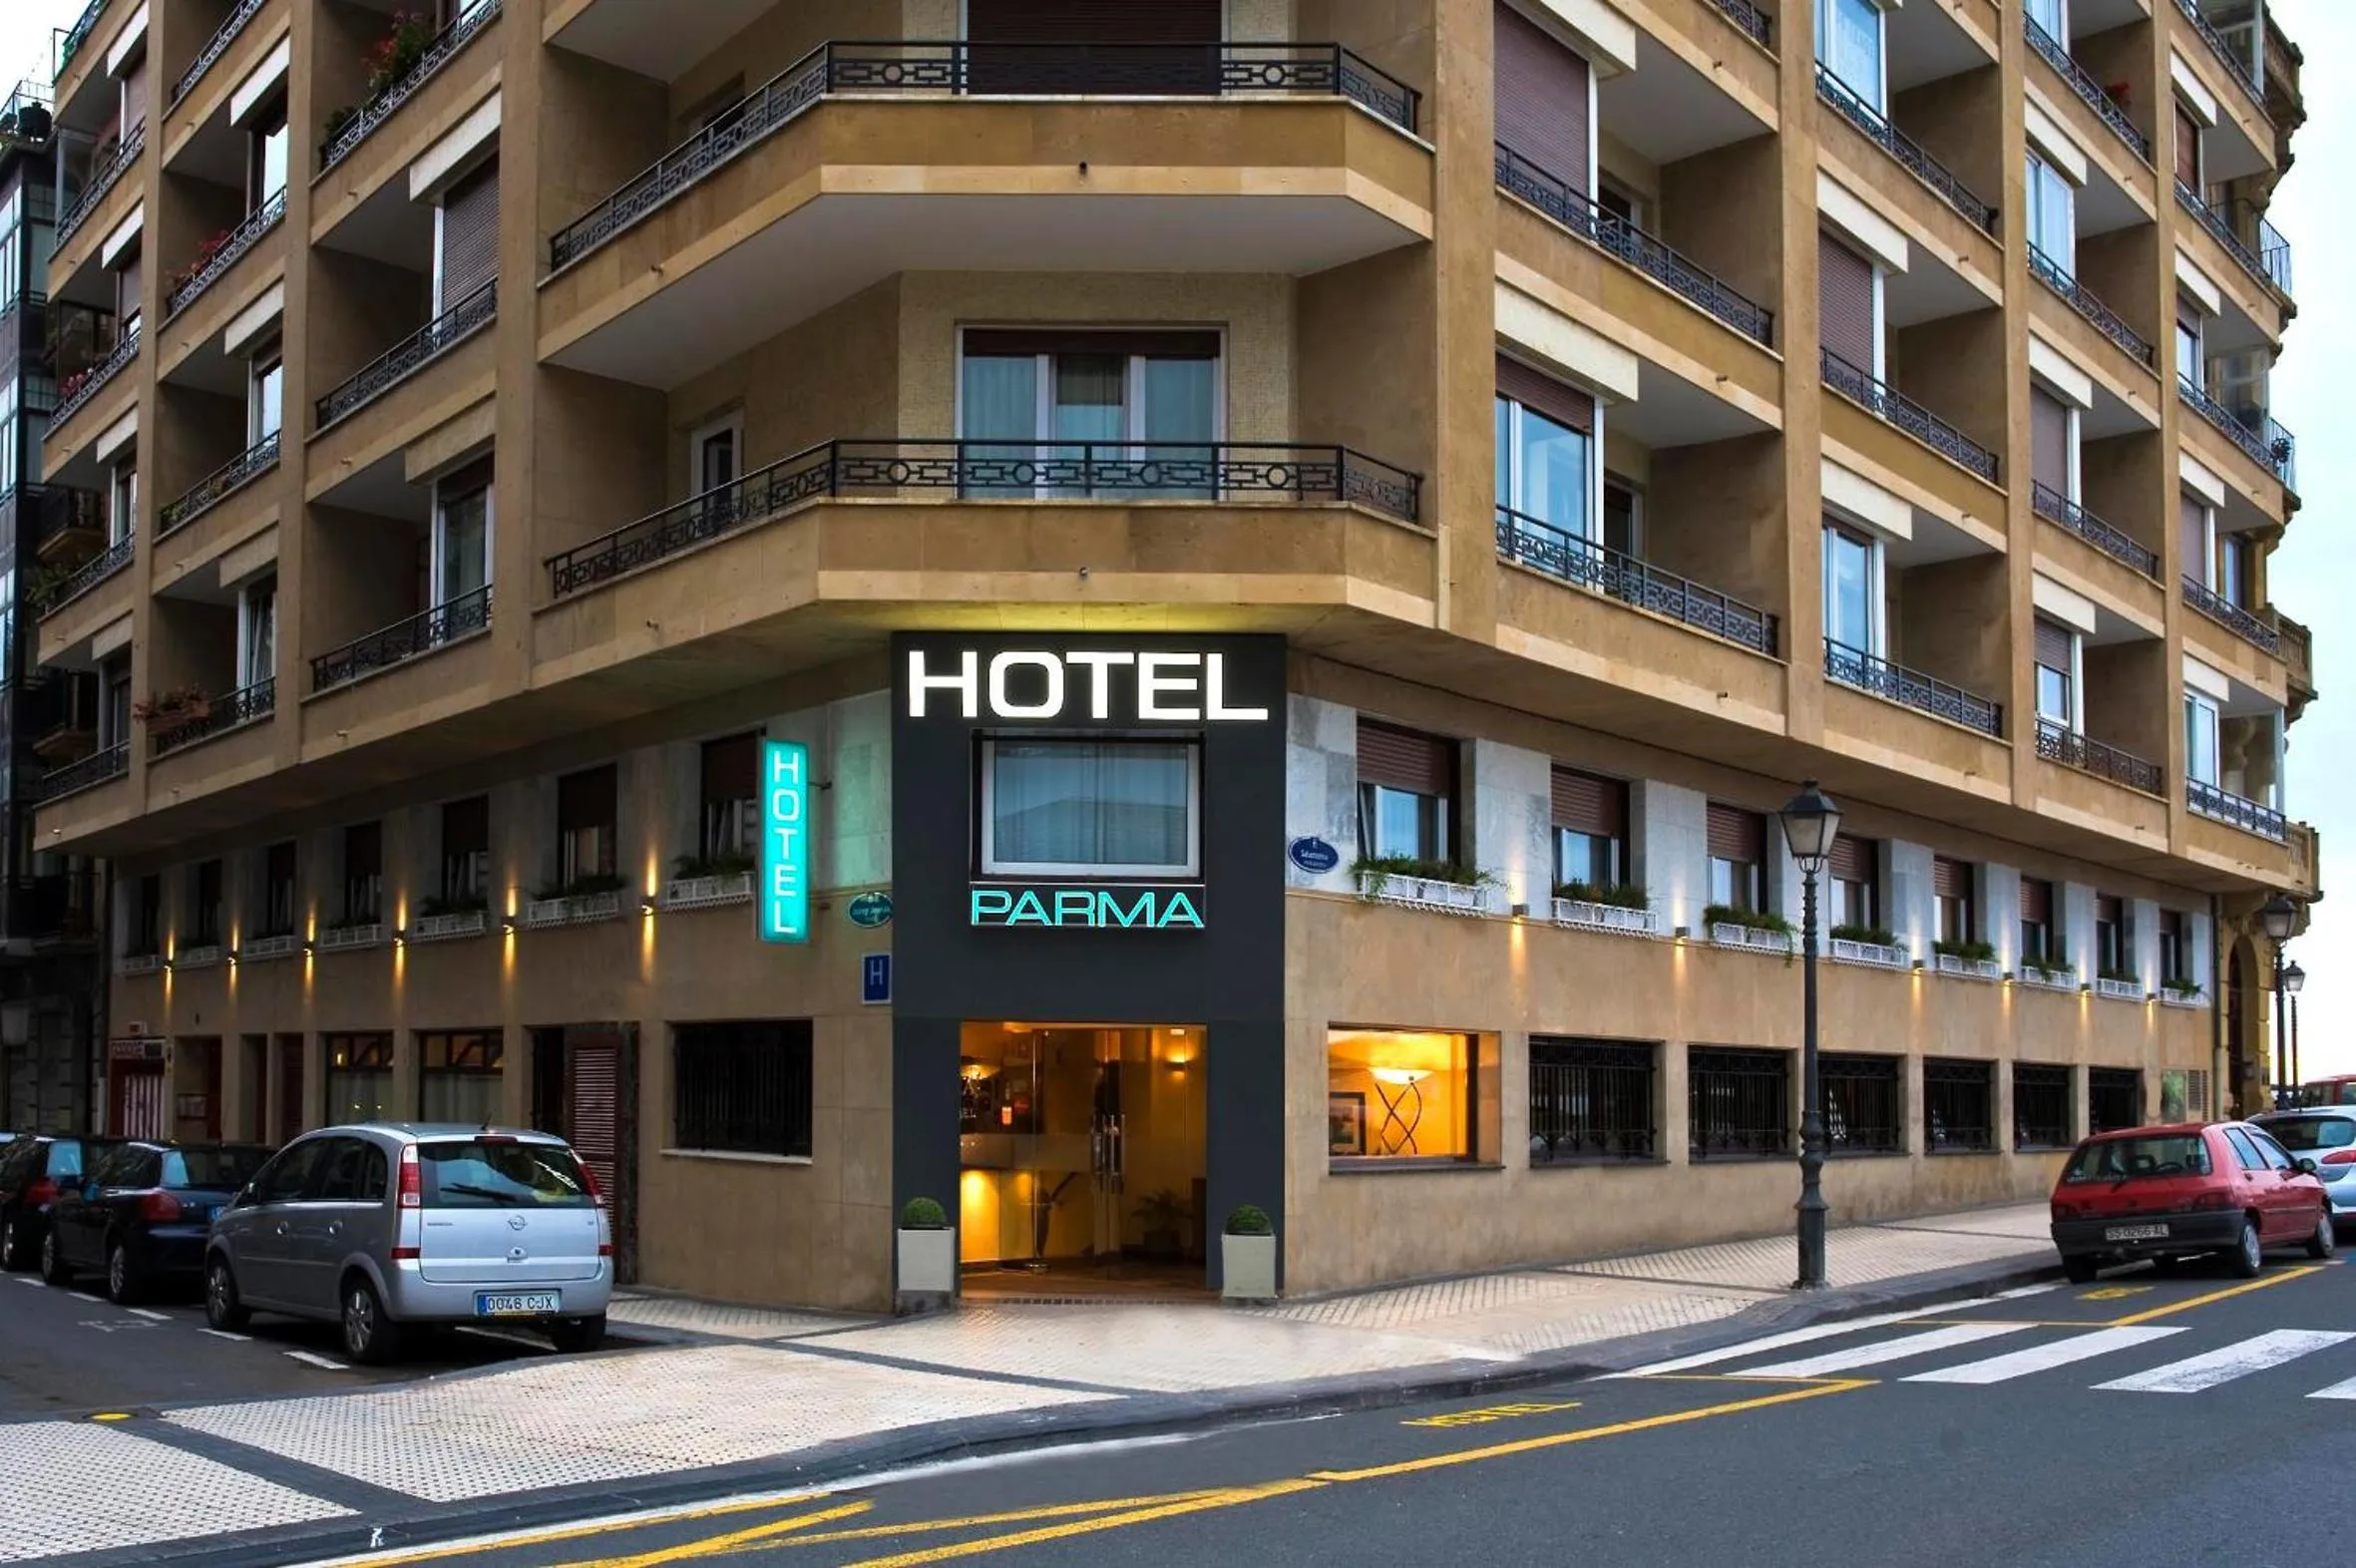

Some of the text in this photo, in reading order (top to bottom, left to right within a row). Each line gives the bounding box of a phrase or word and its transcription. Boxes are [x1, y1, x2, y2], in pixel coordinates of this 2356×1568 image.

[909, 650, 1269, 720] HOTEL
[772, 751, 800, 935] HOTEL
[971, 890, 1205, 928] PARMA
[870, 959, 884, 986] H
[527, 1296, 555, 1310] CJX
